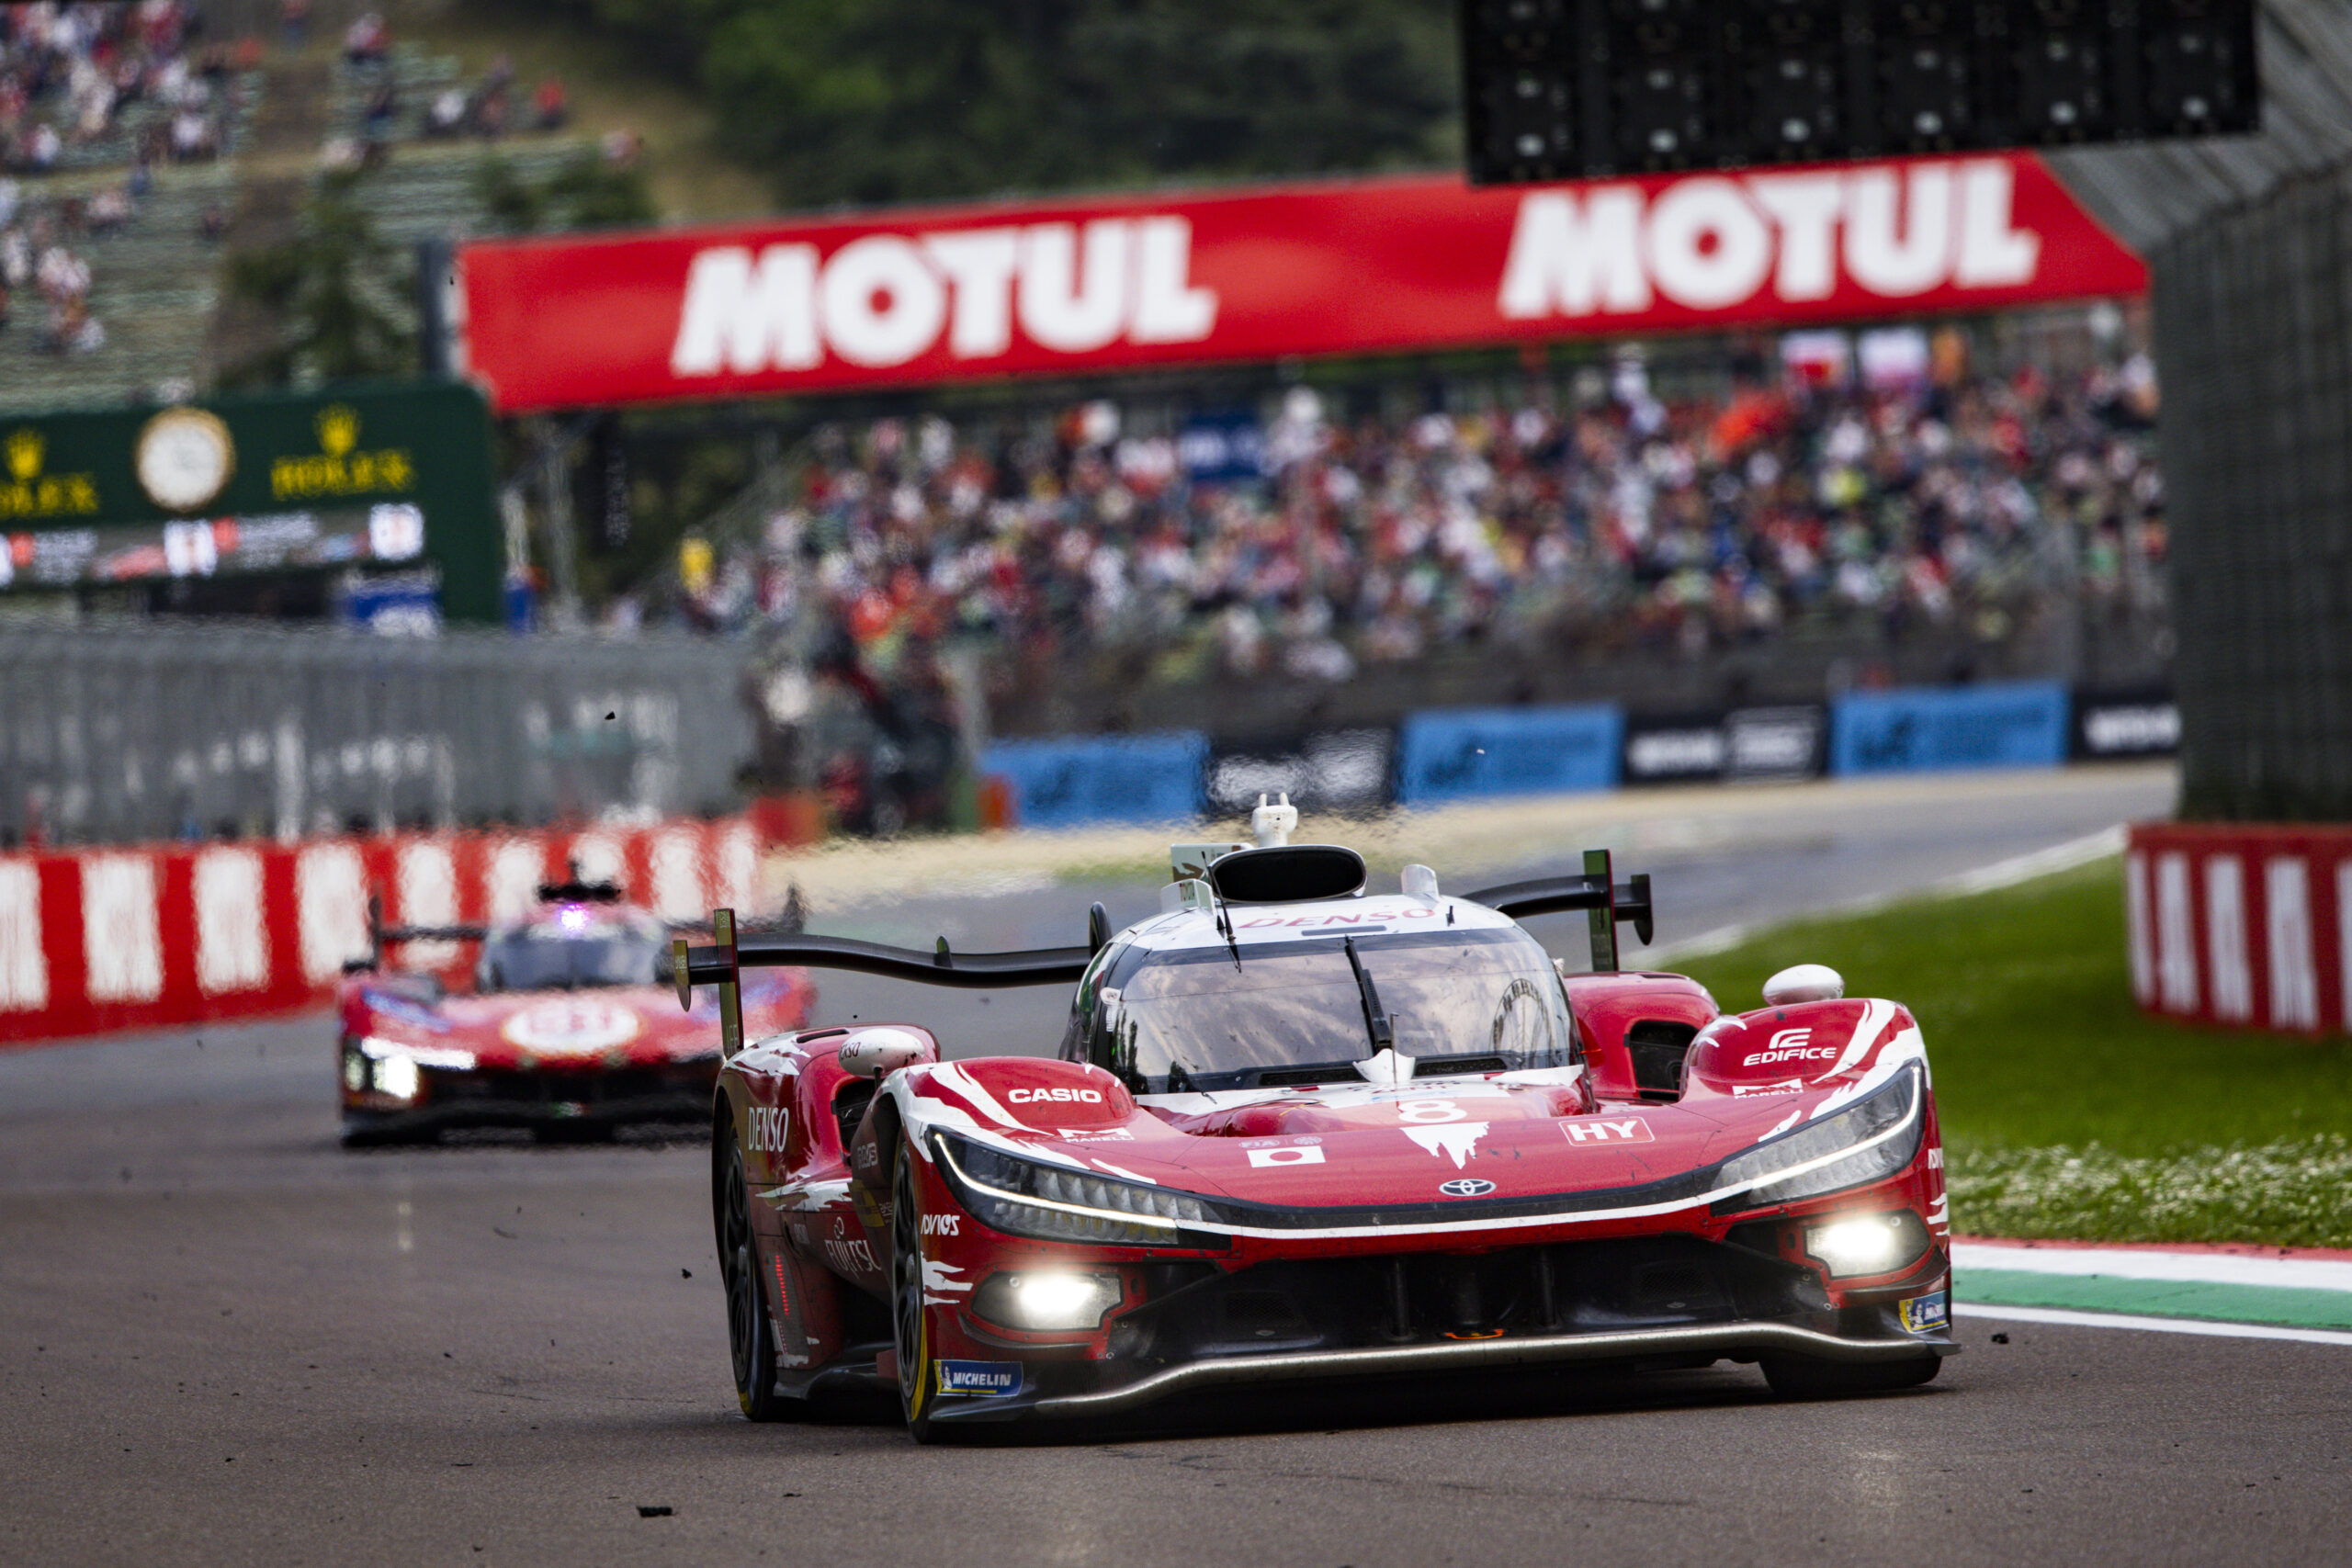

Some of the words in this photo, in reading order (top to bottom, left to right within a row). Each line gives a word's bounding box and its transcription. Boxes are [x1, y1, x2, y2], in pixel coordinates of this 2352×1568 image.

[1498, 158, 2041, 318] MOTUL
[671, 215, 1218, 377] MOTUL
[1238, 908, 1436, 929] DENSO
[1743, 1047, 1837, 1066] EDIFICE
[1008, 1088, 1102, 1103] CASIO
[1735, 1089, 1804, 1100] MARELLI
[1398, 1100, 1468, 1124] 8
[748, 1107, 789, 1153] DENSO
[1065, 1135, 1135, 1144] MARELLI
[1566, 1120, 1638, 1142] HY
[952, 1371, 1012, 1387] MICHELIN
